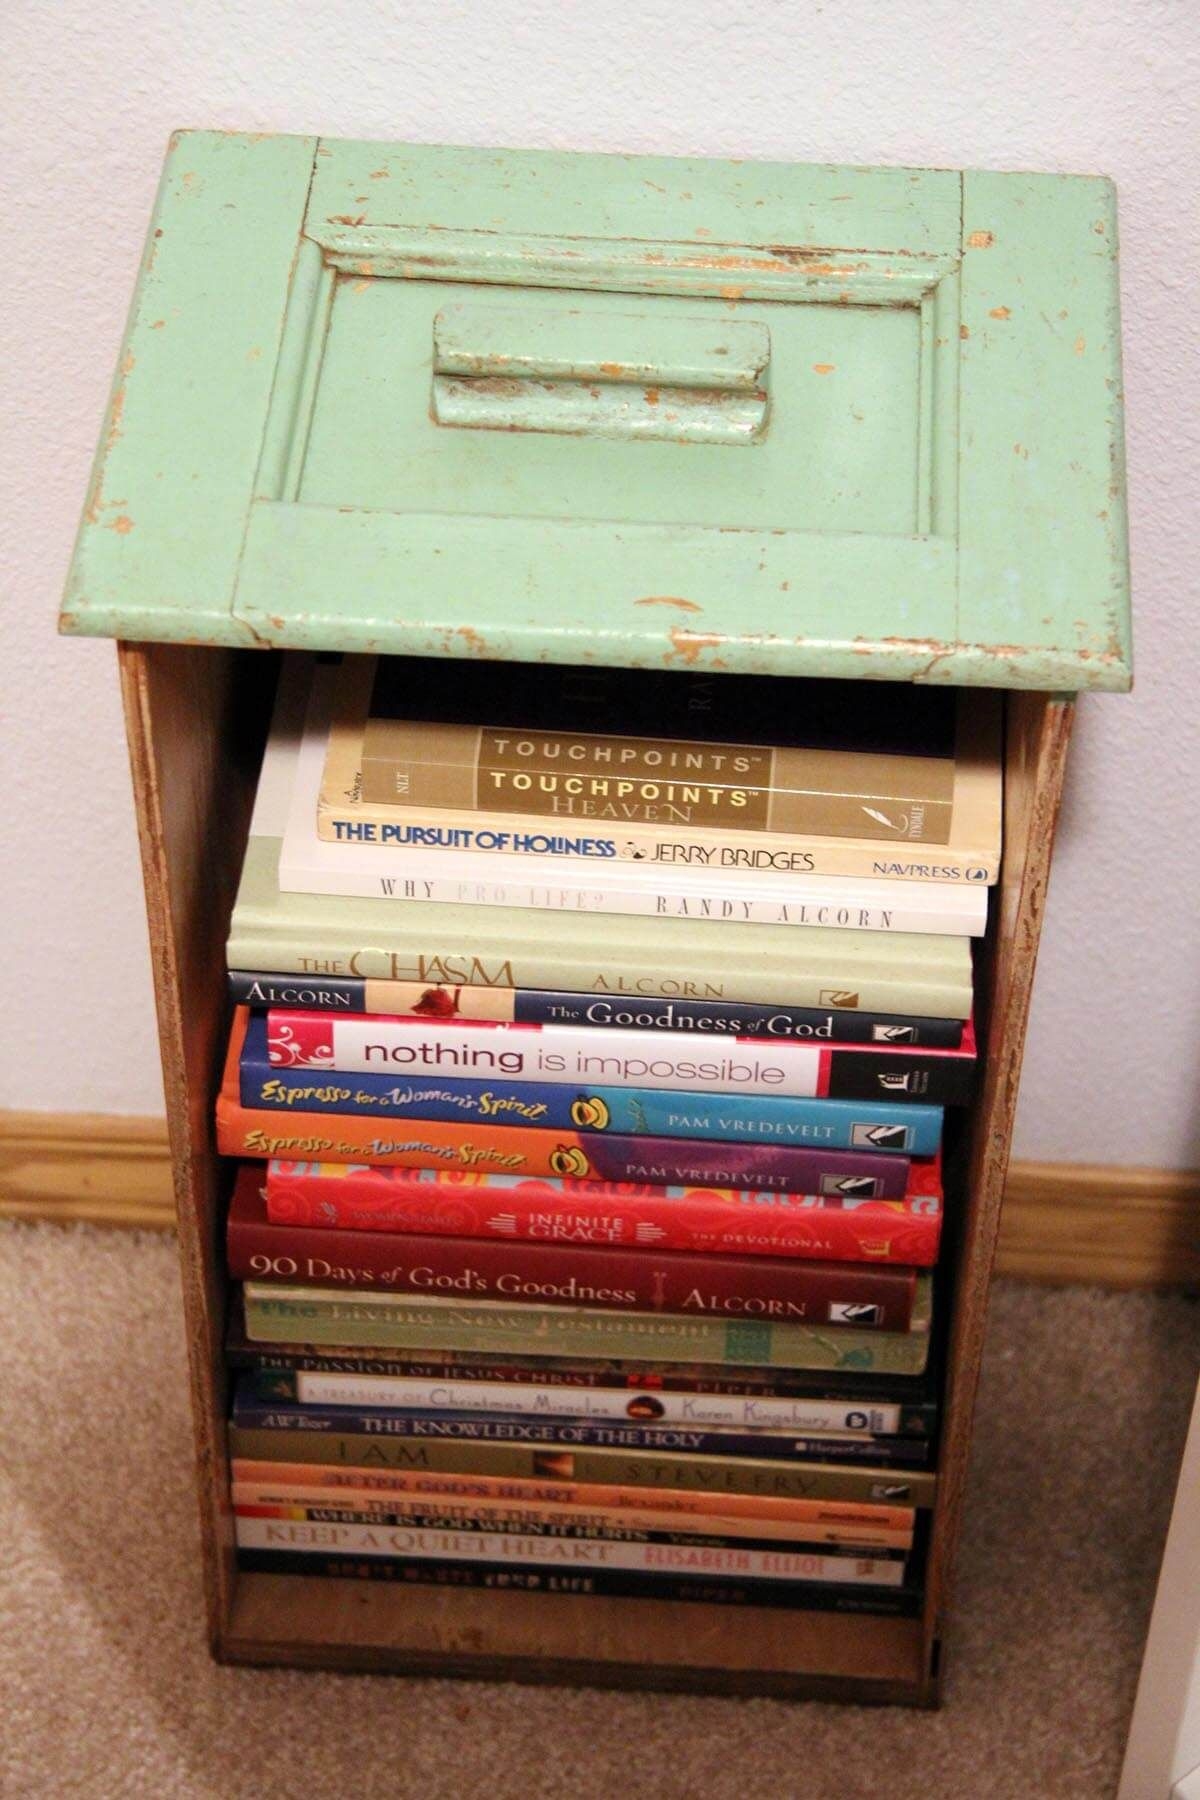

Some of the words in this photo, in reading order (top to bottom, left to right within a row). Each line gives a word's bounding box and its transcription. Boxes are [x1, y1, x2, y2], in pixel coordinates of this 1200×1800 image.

[551, 795, 692, 823] HEAVEN
[332, 821, 377, 841] THE
[382, 824, 473, 848] PURSUIT
[475, 831, 509, 850] OF
[513, 834, 617, 857] HOLINESS
[651, 843, 717, 866] JERRY
[721, 848, 815, 871] BRIDGES
[873, 862, 960, 880] NAVPRESS
[380, 878, 434, 898] WHY
[656, 896, 753, 919] RANDY
[777, 905, 893, 928] ALCORN
[298, 957, 345, 973] THE
[350, 947, 515, 986] CHASM
[246, 981, 350, 1005] ALCORN
[592, 974, 724, 997] ALCORN
[547, 1006, 580, 1019] The
[586, 1002, 741, 1032] Goodness
[747, 1018, 765, 1032] of
[767, 1014, 833, 1038] God
[364, 1042, 524, 1074] nothing
[538, 1049, 566, 1071] is
[577, 1051, 785, 1085] impossible
[260, 1080, 351, 1104] Espresso
[479, 1092, 548, 1120] Spirit
[668, 1115, 710, 1129] PAM
[718, 1119, 835, 1138] VREDEVELT
[244, 1130, 333, 1153] Espresso
[458, 1143, 528, 1169] Spirit
[625, 1164, 667, 1178] PAM
[675, 1167, 790, 1187] VREDEVELT
[528, 1213, 624, 1230] INFINITE
[528, 1225, 623, 1242] GRACE
[722, 1233, 833, 1249] DEVOTIONAL
[250, 1254, 298, 1276] 90
[307, 1258, 374, 1283] Days
[381, 1266, 402, 1283] of
[409, 1266, 488, 1290] God's
[496, 1274, 637, 1303] Goodness
[682, 1288, 807, 1316] ALCORN
[682, 1397, 734, 1420] Karen
[743, 1401, 831, 1427] Kingsbury
[360, 1417, 407, 1433] THE
[412, 1420, 554, 1440] KNOWLEDGE
[558, 1427, 589, 1441] OF
[597, 1429, 641, 1444] THE
[644, 1431, 705, 1448] HOLY
[362, 1443, 430, 1466] AM
[265, 1524, 350, 1544] KEEP
[362, 1530, 380, 1548] A
[390, 1531, 493, 1551] QUIET
[502, 1536, 614, 1561] HEART
